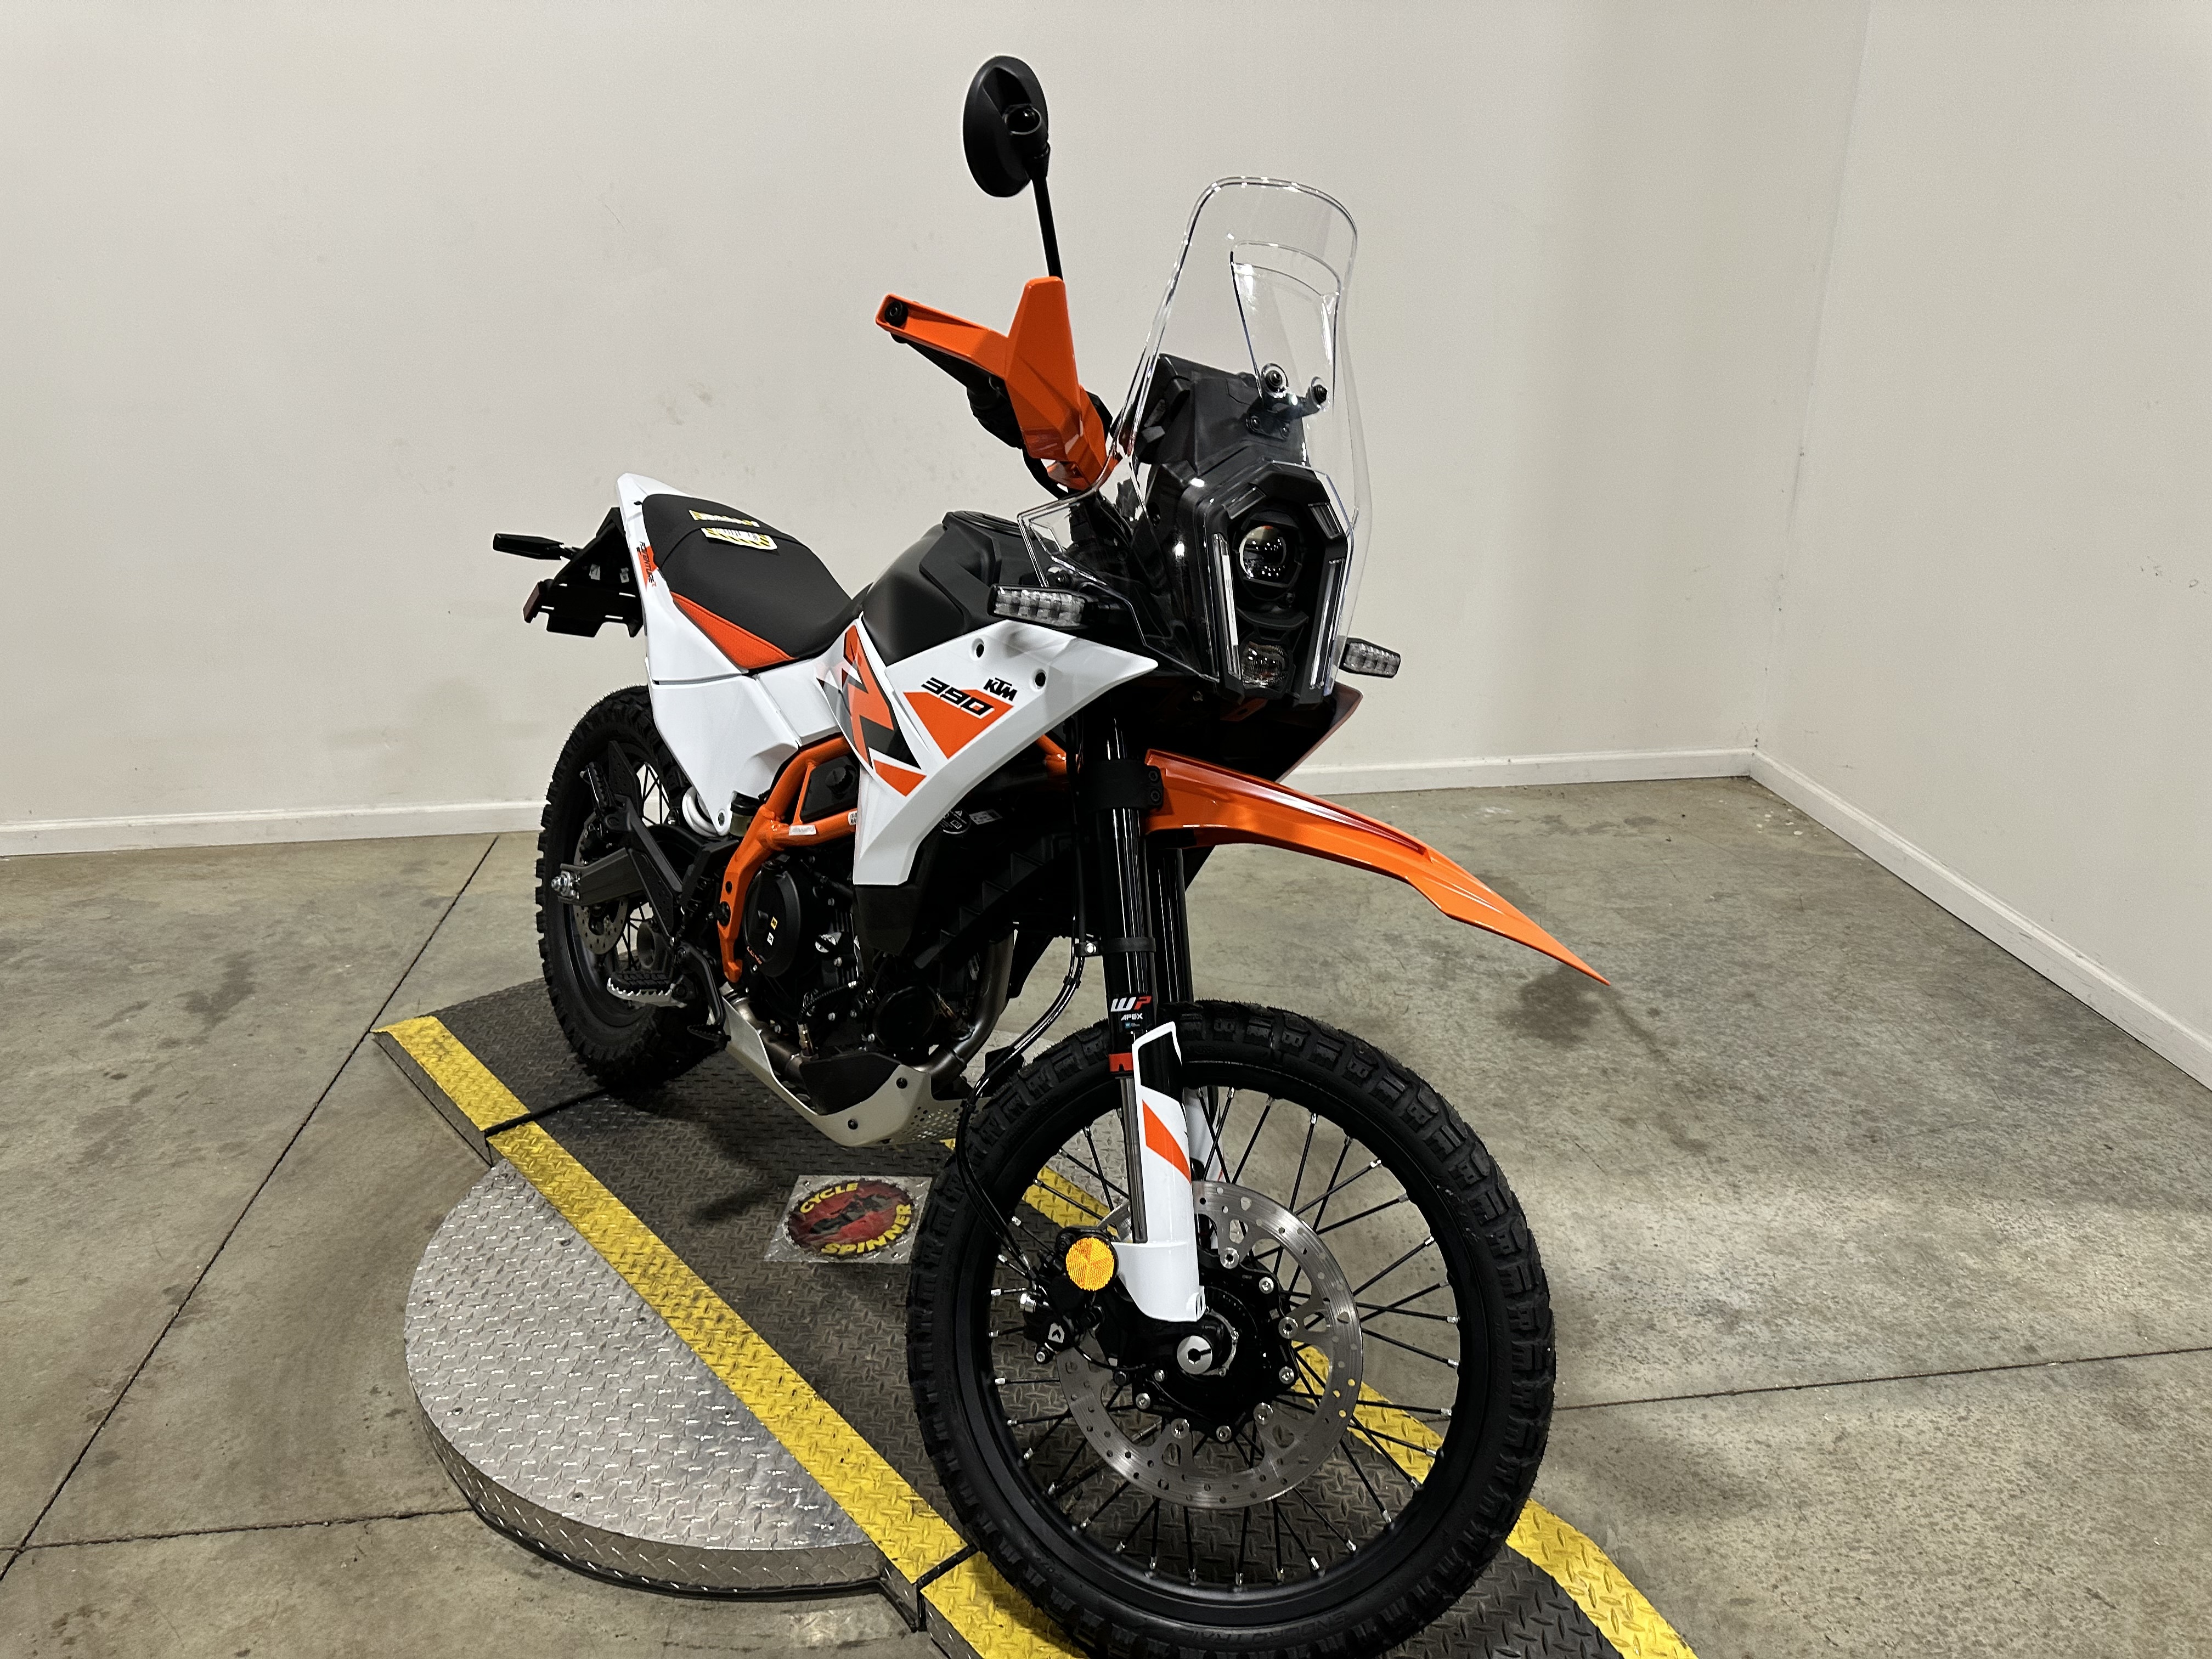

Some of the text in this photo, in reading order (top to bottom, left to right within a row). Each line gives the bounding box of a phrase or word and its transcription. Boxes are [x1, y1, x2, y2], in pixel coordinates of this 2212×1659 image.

[639, 541, 654, 583] ADVENTURE
[921, 677, 995, 716] 390
[983, 677, 1018, 702] KTM
[1110, 996, 1152, 1012] WP
[800, 1182, 859, 1214] CYCLE
[821, 1204, 912, 1255] SPINNER
